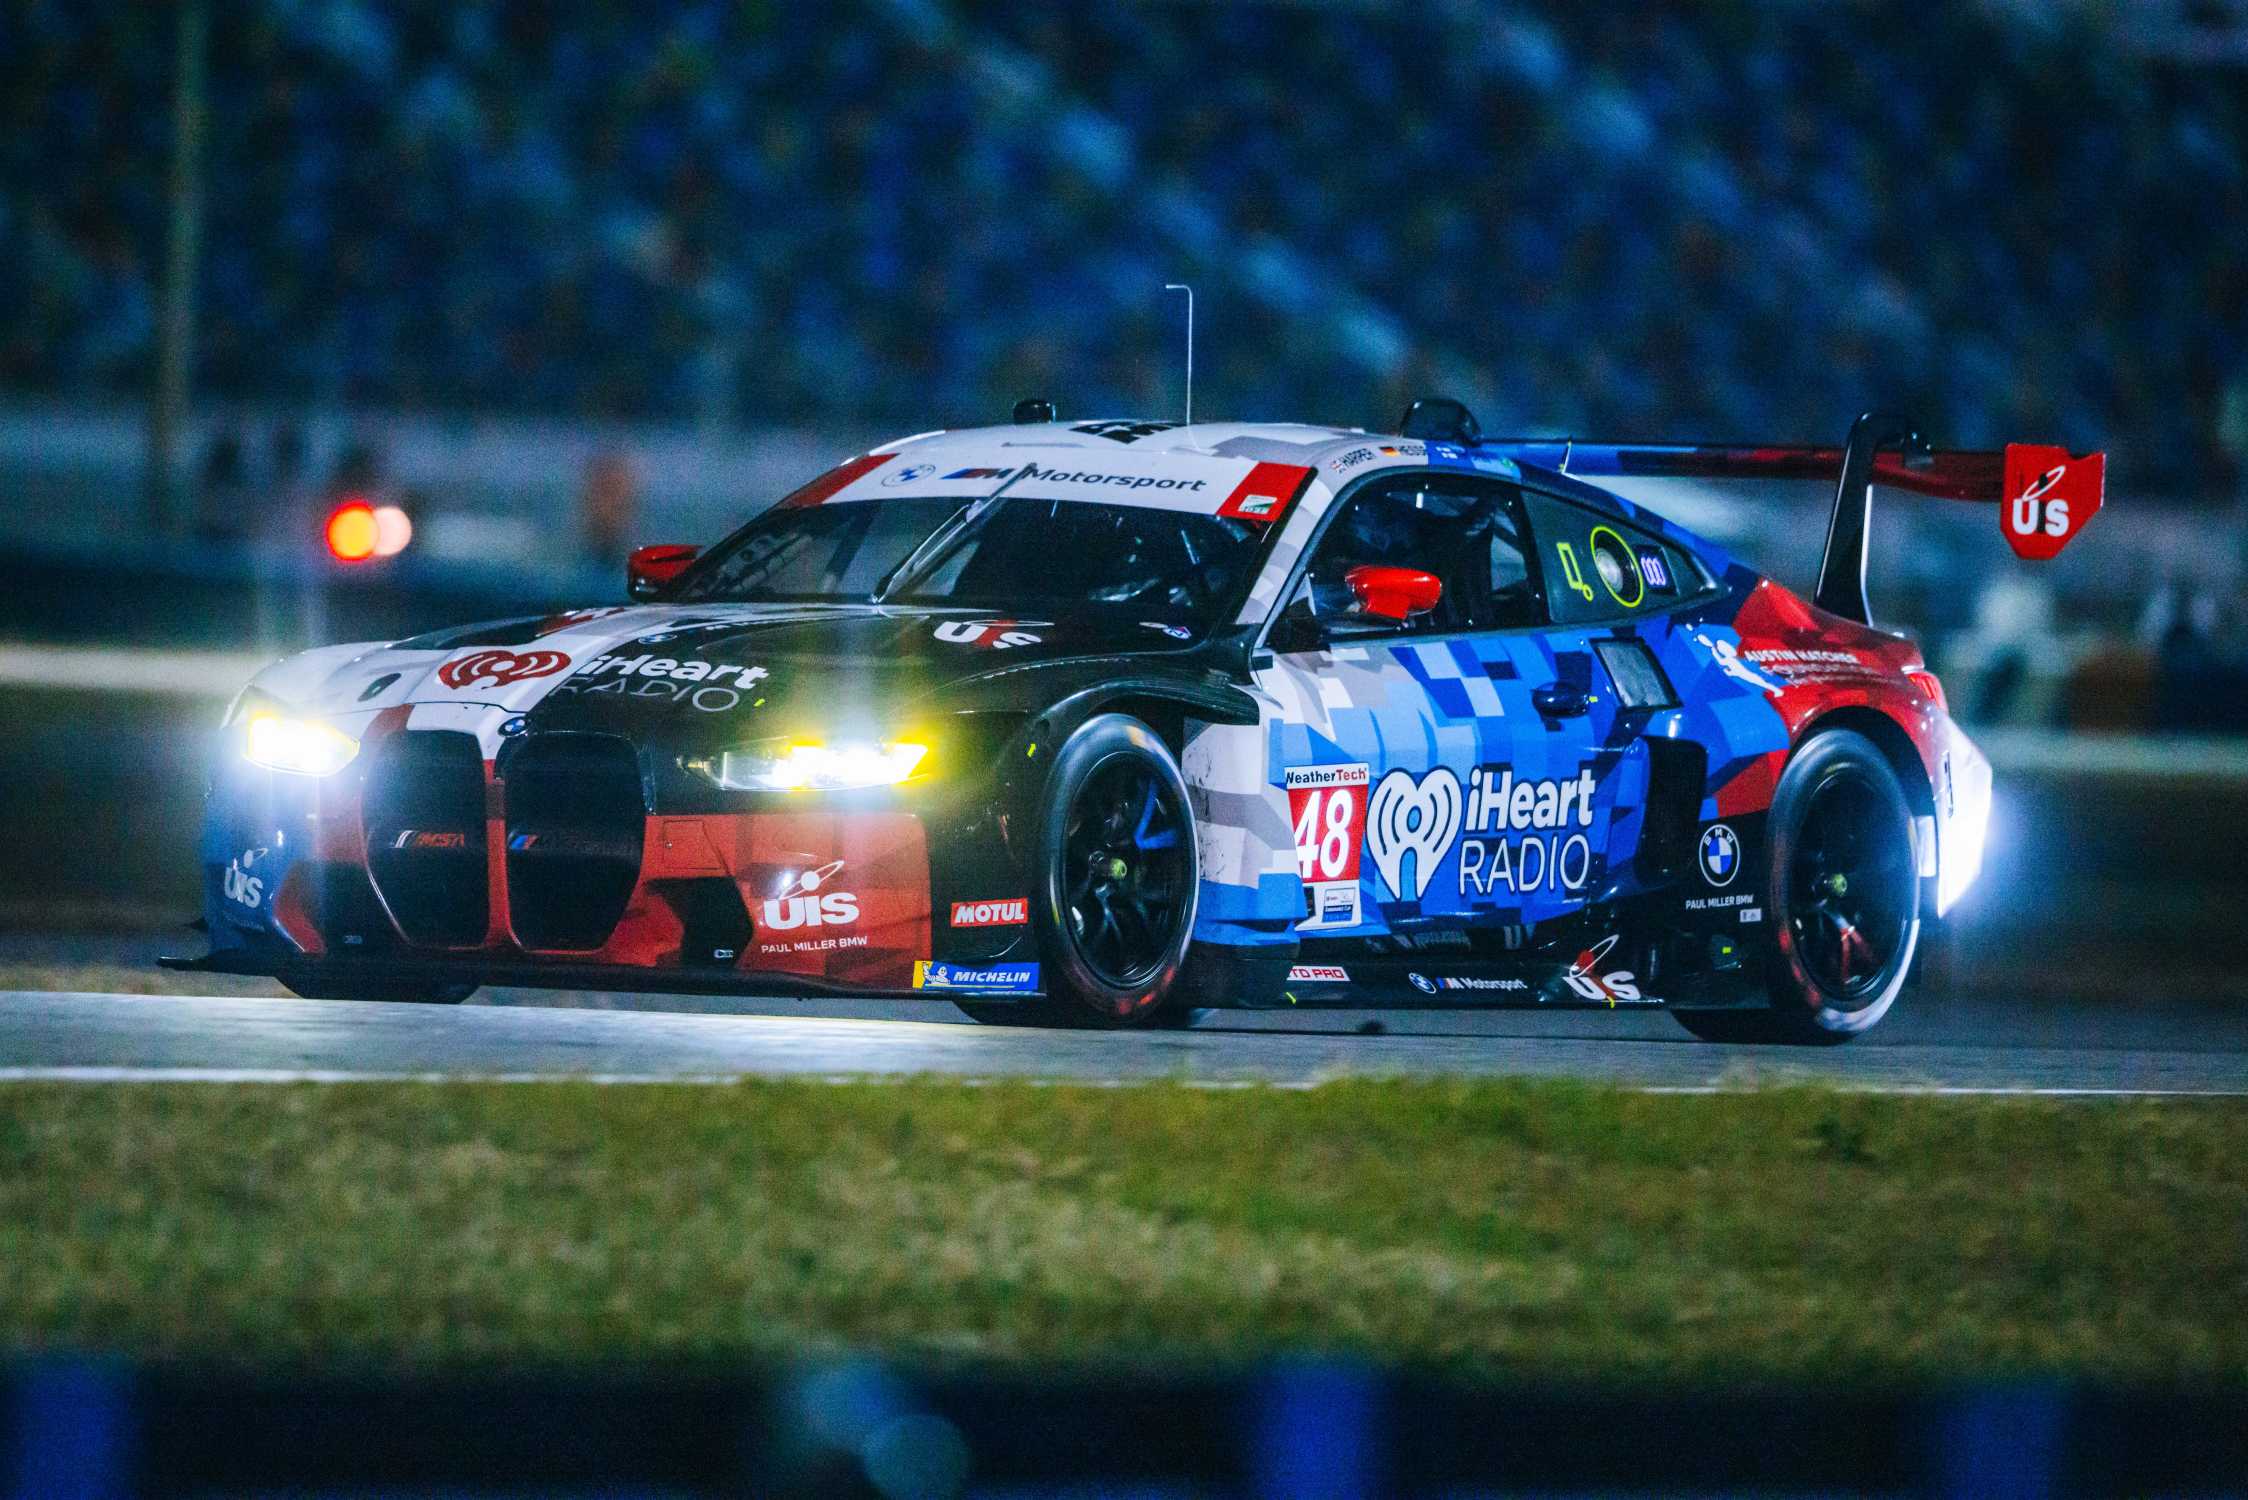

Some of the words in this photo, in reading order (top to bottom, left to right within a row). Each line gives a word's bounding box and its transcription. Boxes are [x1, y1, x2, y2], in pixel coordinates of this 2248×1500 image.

[1022, 468, 1207, 491] Motorsport
[1464, 765, 1596, 832] iHeart
[1294, 788, 1354, 880] 48
[1458, 833, 1591, 895] RADIO
[954, 902, 1026, 925] MOTUL
[1685, 899, 1707, 911] PAUL
[1707, 896, 1736, 908] MILLER
[761, 942, 792, 954] PAUL
[794, 939, 837, 952] MILLER
[838, 935, 869, 949] BMW
[953, 971, 1032, 984] MICHELIN
